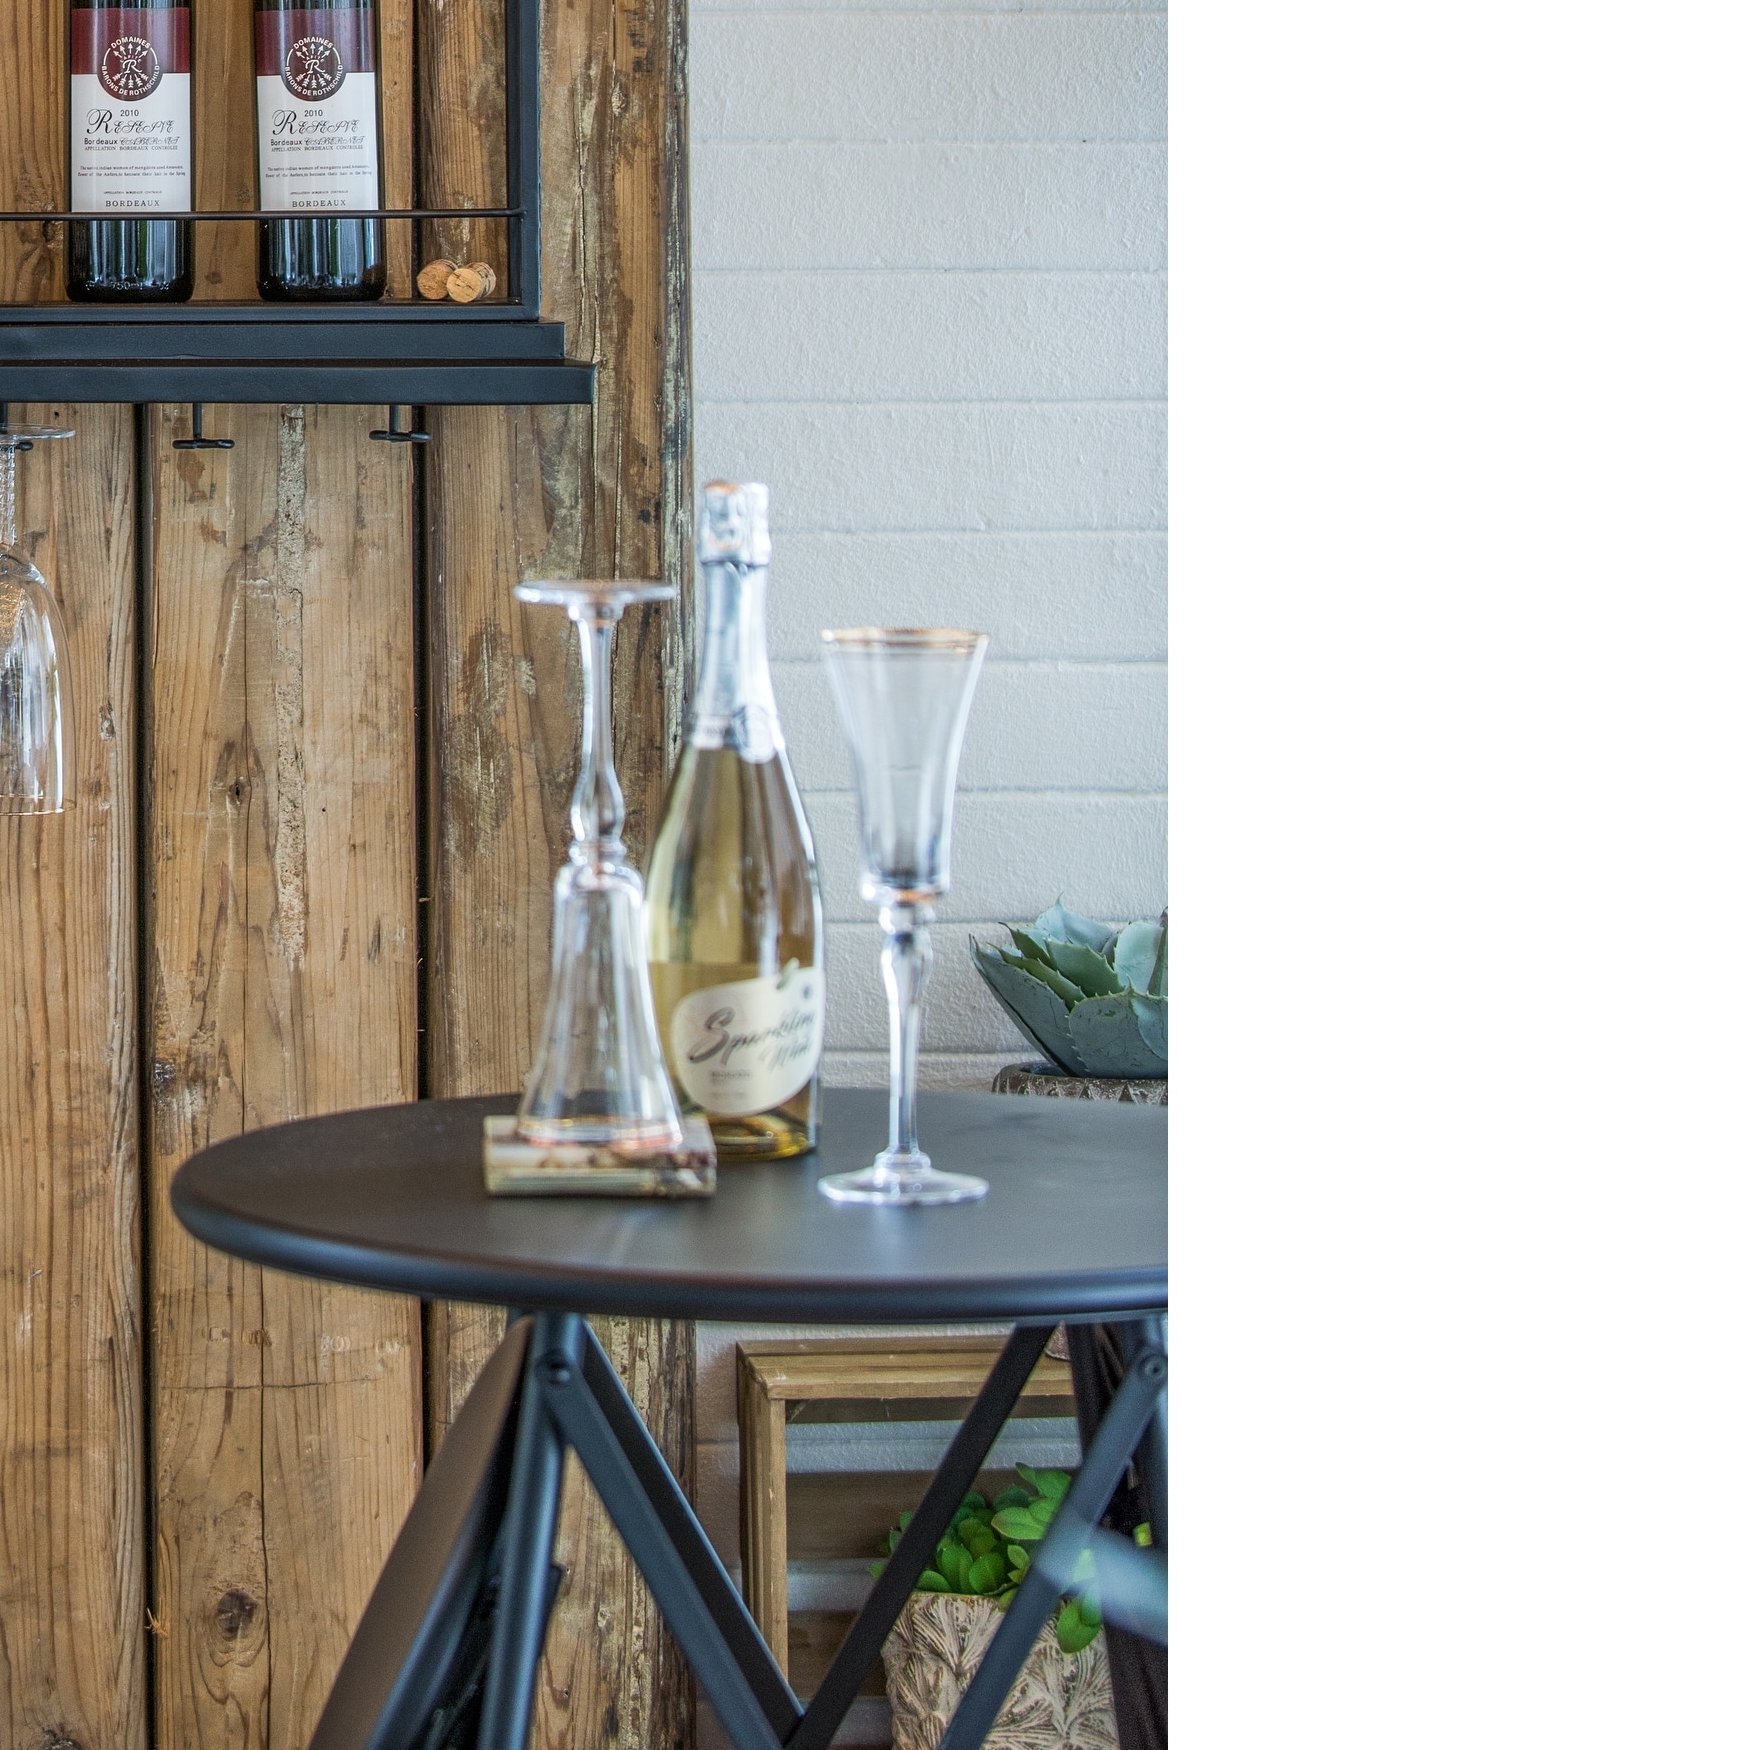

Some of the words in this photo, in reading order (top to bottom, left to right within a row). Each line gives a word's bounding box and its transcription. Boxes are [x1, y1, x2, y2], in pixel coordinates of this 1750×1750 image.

[110, 36, 151, 49] DOMAINES
[293, 36, 334, 50] DOMAINES
[101, 65, 119, 92] BARONS
[129, 65, 160, 96] ROTHSCHILD
[284, 66, 303, 92] BARONS
[312, 65, 344, 96] ROTHSCHILD
[120, 109, 139, 117] 2010
[304, 109, 323, 117] 2010
[84, 137, 118, 145] Bordeaux
[270, 138, 303, 146] Bordeaux
[292, 199, 346, 208] BORDEAUX
